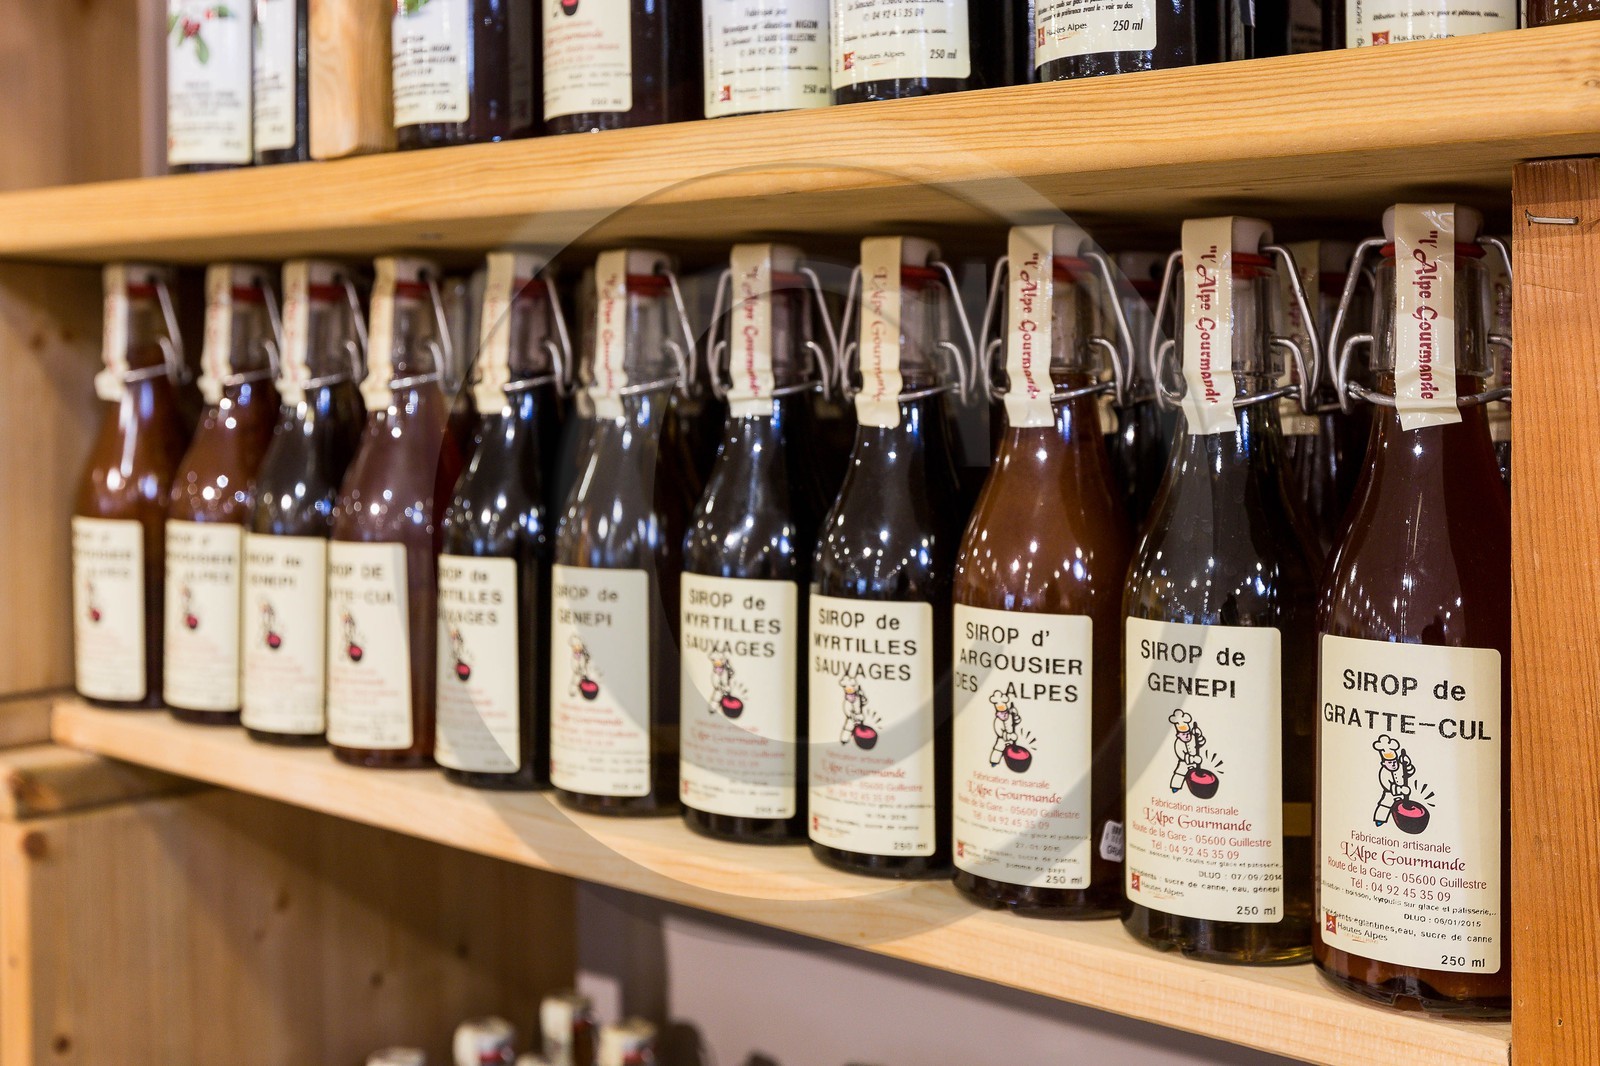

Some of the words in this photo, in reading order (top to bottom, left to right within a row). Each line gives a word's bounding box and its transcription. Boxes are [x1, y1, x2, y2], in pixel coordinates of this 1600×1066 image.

[1113, 20, 1129, 31] 250
[1132, 18, 1143, 30] ml
[930, 49, 945, 59] 250
[947, 49, 957, 59] ml
[1412, 305, 1439, 400] Gourmande
[598, 588, 618, 602] de
[689, 589, 733, 607] SIROP
[743, 595, 765, 610] de
[558, 608, 612, 627] GENEPI
[686, 612, 781, 635] MYRTILLES
[819, 609, 864, 628] SIROP
[877, 614, 899, 630] de
[967, 622, 1019, 644] SIROP
[1032, 630, 1049, 646] d'
[686, 634, 775, 658] SAUVAGES
[814, 632, 917, 656] MYRTILLES
[1141, 639, 1203, 663] SIROP
[1217, 648, 1246, 667] de
[815, 656, 911, 681] SAUVAGES
[961, 648, 1082, 675] ARGOUSIER
[1006, 682, 1078, 702] ALPES
[1148, 672, 1236, 698] GENEPI
[1343, 669, 1418, 696] SIROP
[1433, 680, 1466, 701] de
[995, 788, 1061, 804] Gourmande
[1010, 806, 1038, 817] 05600
[1041, 810, 1080, 820] Guillestre
[1152, 797, 1193, 812] Fabrication
[1196, 806, 1239, 816] artisanale
[1143, 807, 1174, 826] L'Alpe
[1178, 814, 1252, 832] Gourmande
[1168, 830, 1187, 842] Gare
[1196, 835, 1226, 846] 05600
[1229, 838, 1272, 848] Guillestre
[1351, 830, 1399, 848] Fabrication
[1403, 840, 1451, 854] artisanale
[1169, 843, 1179, 853] 04
[1183, 846, 1194, 856] 92
[1197, 848, 1209, 858] 45
[1212, 849, 1224, 859] 35
[1227, 850, 1240, 860] 09
[1340, 841, 1377, 864] L'Alpe
[1381, 849, 1466, 872] Gourmande
[1046, 875, 1066, 884] 250
[1199, 870, 1221, 880] DLUO
[1231, 873, 1282, 881] 07/09/2014
[1327, 856, 1346, 871] Route
[1347, 862, 1358, 873] de
[1360, 864, 1367, 876] la
[1369, 867, 1392, 880] Gare
[1401, 873, 1436, 886] 05600
[1439, 877, 1487, 890] Guillestre
[1201, 884, 1228, 893] canne,
[1351, 877, 1363, 889] Tél
[1371, 881, 1383, 893] 04
[1386, 884, 1400, 896] 92
[1403, 888, 1417, 899] 45
[1420, 889, 1434, 901] 35
[1437, 891, 1451, 903] 09
[1236, 906, 1259, 916] 250
[1264, 907, 1276, 915] ml
[1404, 901, 1415, 909] sur
[1404, 914, 1426, 922] DLUO
[1434, 918, 1481, 927] 06/01/2015
[1338, 922, 1361, 935] Hautes
[1364, 930, 1388, 941] Alpes
[1421, 931, 1446, 940] sucre
[1441, 955, 1465, 966] 250
[1471, 958, 1485, 967] ml
